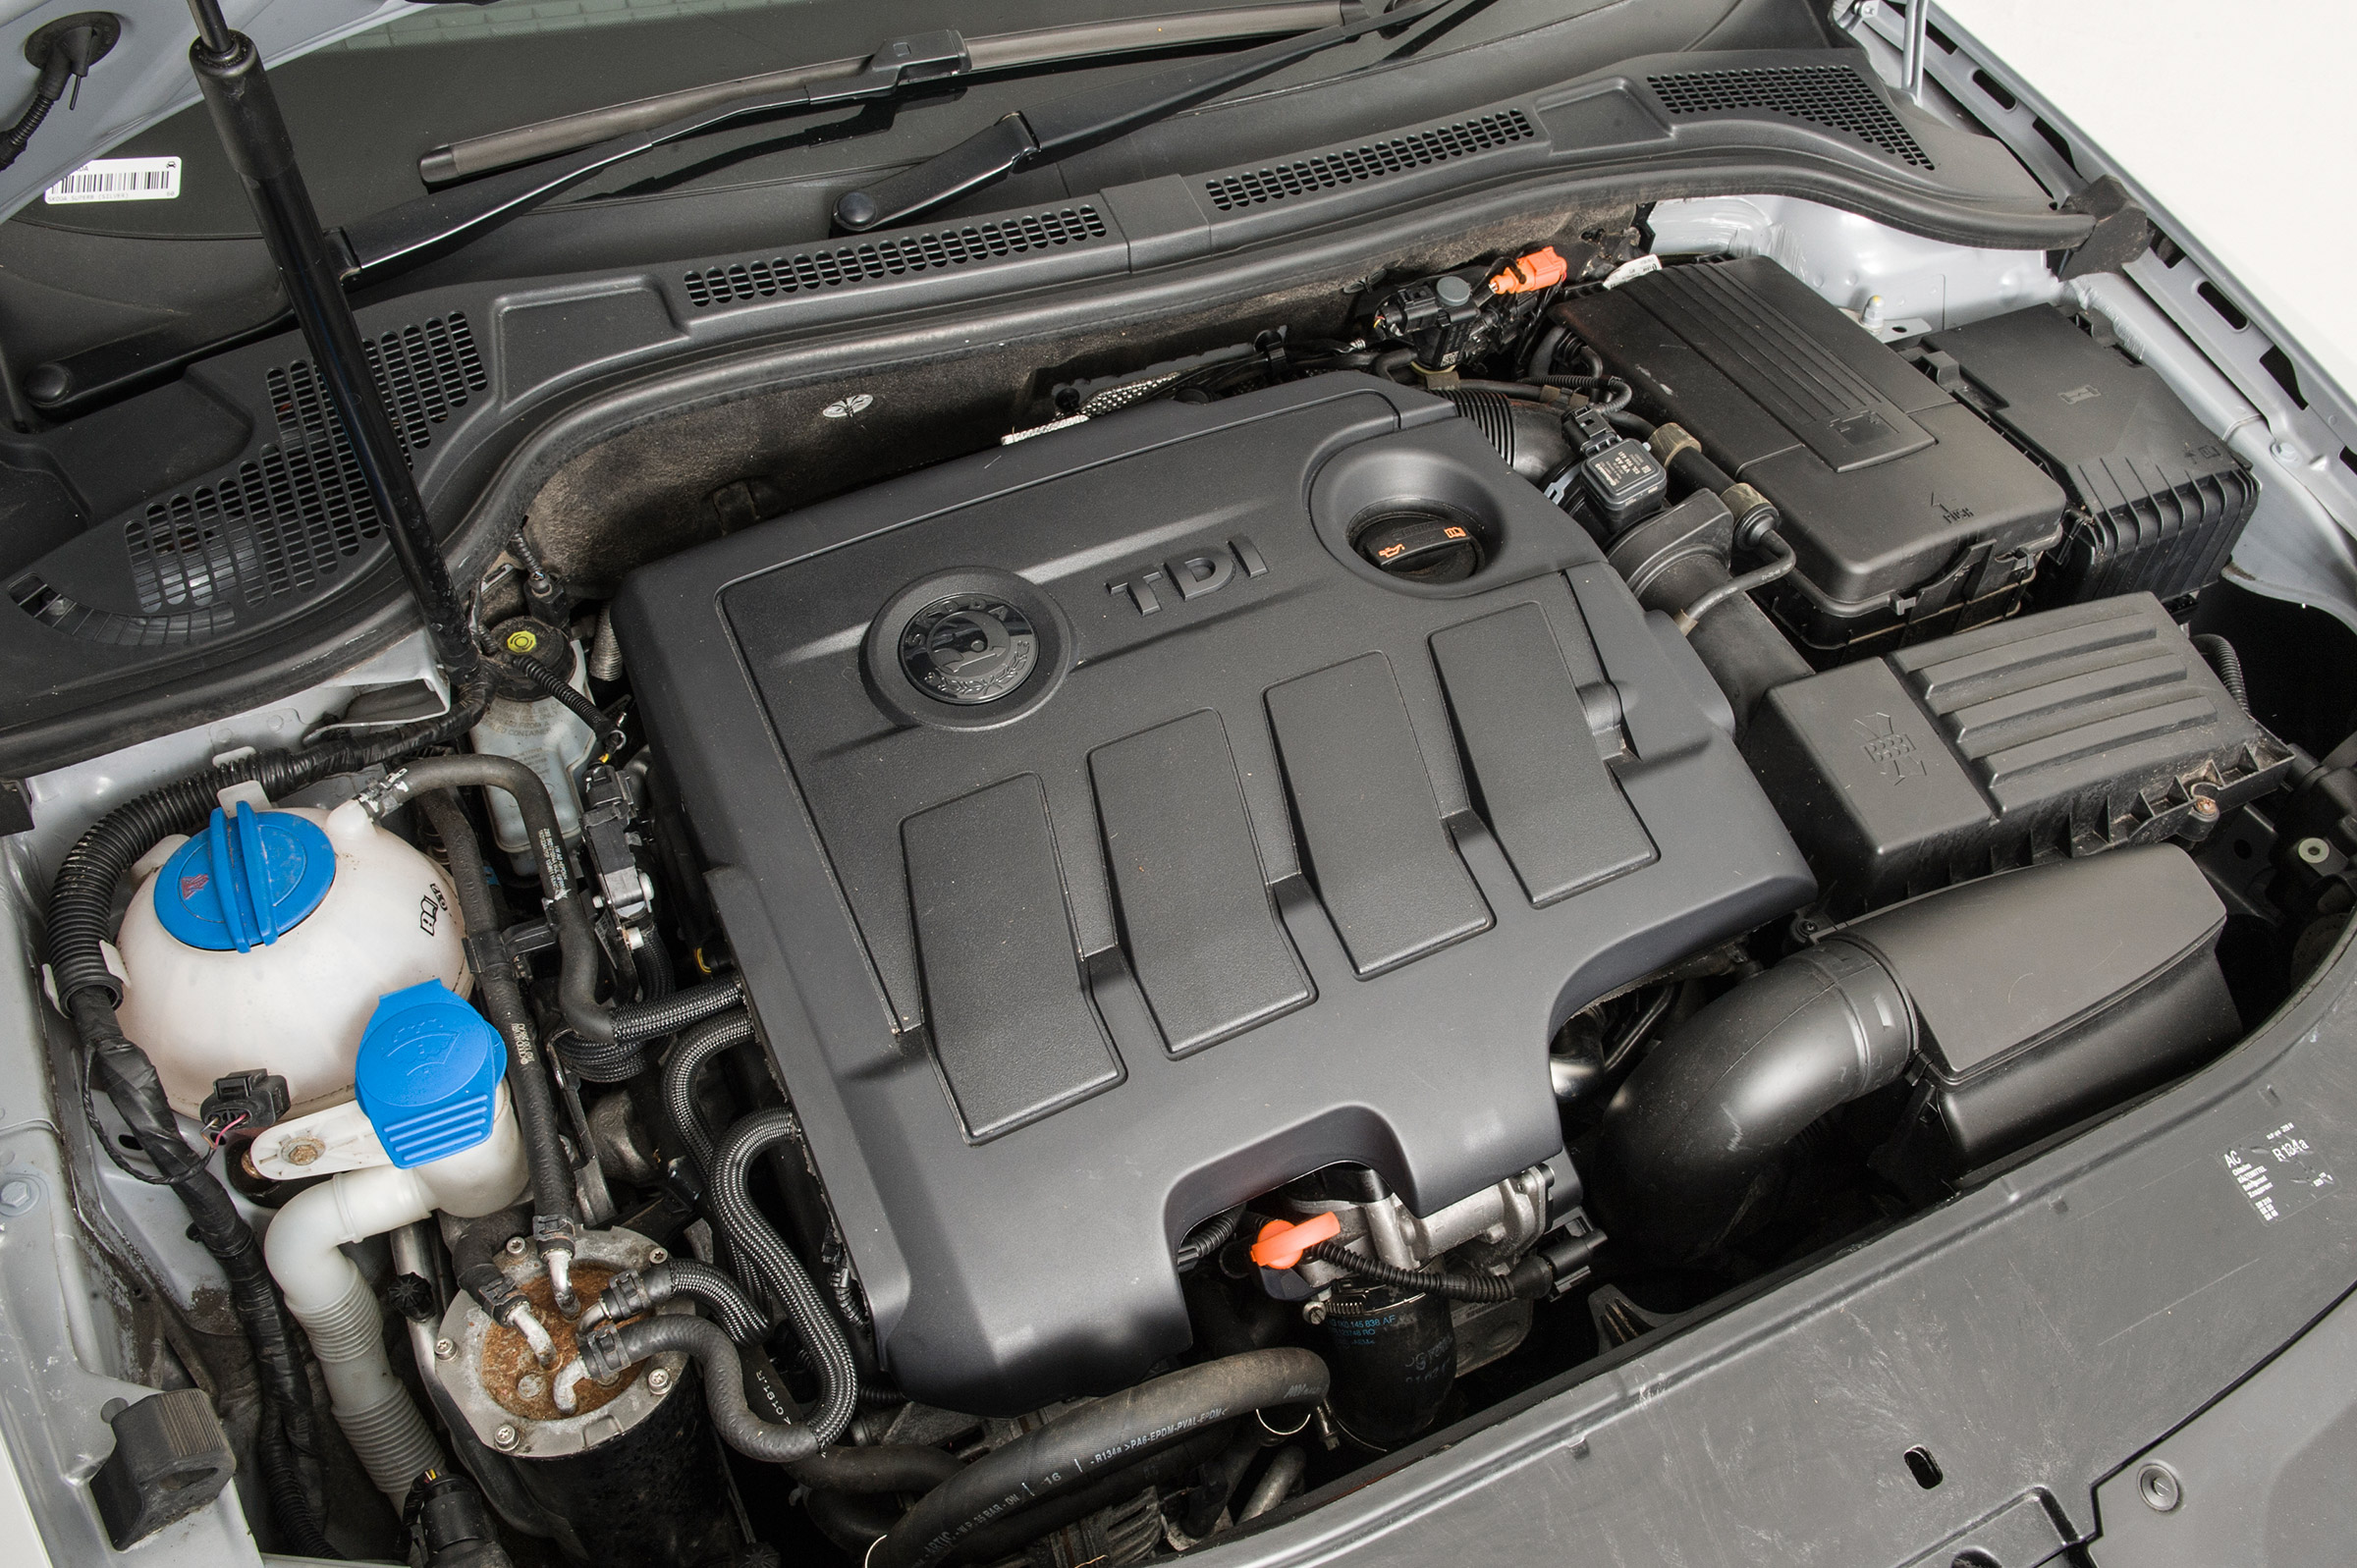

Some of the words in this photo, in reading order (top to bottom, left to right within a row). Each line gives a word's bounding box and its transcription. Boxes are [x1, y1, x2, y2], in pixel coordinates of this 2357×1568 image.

[1104, 535, 1270, 618] TDI
[2223, 1150, 2242, 1168] AC
[1364, 1319, 1381, 1328] 838
[1382, 1314, 1397, 1326] AF
[983, 1503, 1004, 1518] BAR
[1005, 1493, 1020, 1506] DN
[1044, 1472, 1063, 1486] 16
[1094, 1445, 1123, 1464] R134a
